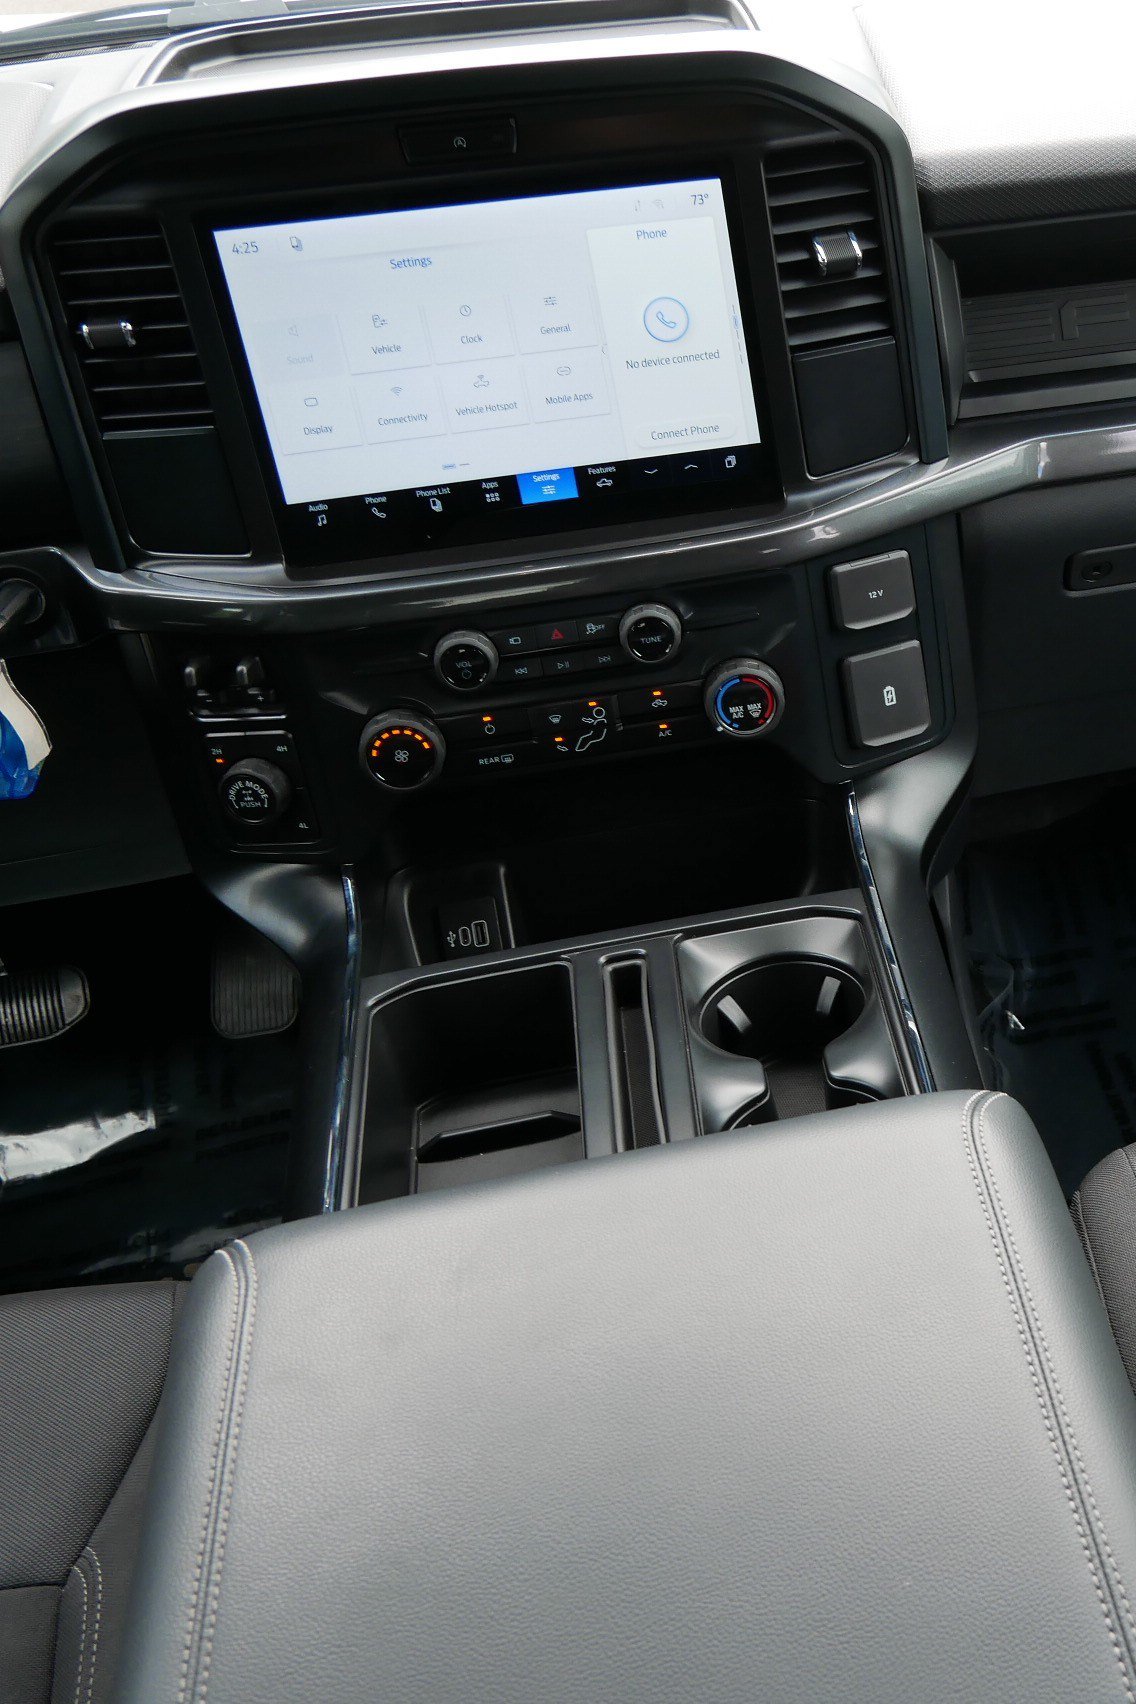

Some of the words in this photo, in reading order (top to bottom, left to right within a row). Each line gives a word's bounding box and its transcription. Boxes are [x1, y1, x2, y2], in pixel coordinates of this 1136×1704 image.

[635, 228, 668, 240] Phone
[231, 241, 259, 255] 4:25
[389, 257, 432, 270] Settings
[540, 323, 572, 335] General
[460, 333, 483, 345] Clock
[371, 343, 402, 356] Vehicle
[286, 354, 314, 366] Sound
[625, 360, 640, 370] No
[641, 356, 671, 368] device
[671, 349, 720, 364] connected
[545, 395, 572, 406] Mobile
[573, 392, 594, 403] Apps
[455, 405, 485, 417] Vehicle
[485, 401, 518, 414] Hotspot
[377, 412, 429, 427] Connectivity
[303, 424, 334, 437] Display
[650, 427, 689, 441] Connect
[690, 423, 720, 437] Phone
[587, 465, 617, 476] Features
[532, 473, 560, 484] Settings
[481, 481, 499, 491] Apps
[415, 488, 438, 498] Phone
[438, 486, 451, 495] List
[365, 496, 387, 505] Phone
[308, 504, 329, 513] Audio
[639, 634, 663, 645] TUNE
[455, 660, 473, 669] VOL
[729, 705, 744, 714] MAX
[747, 702, 762, 711] MAX
[732, 711, 745, 719] A/C
[658, 729, 673, 738] A/C
[210, 747, 223, 756] 2H
[478, 755, 501, 766] REAR
[229, 780, 245, 801] DRIVE
[245, 780, 269, 800] MODE
[239, 800, 262, 808] PUSH
[298, 822, 309, 830] 4L
